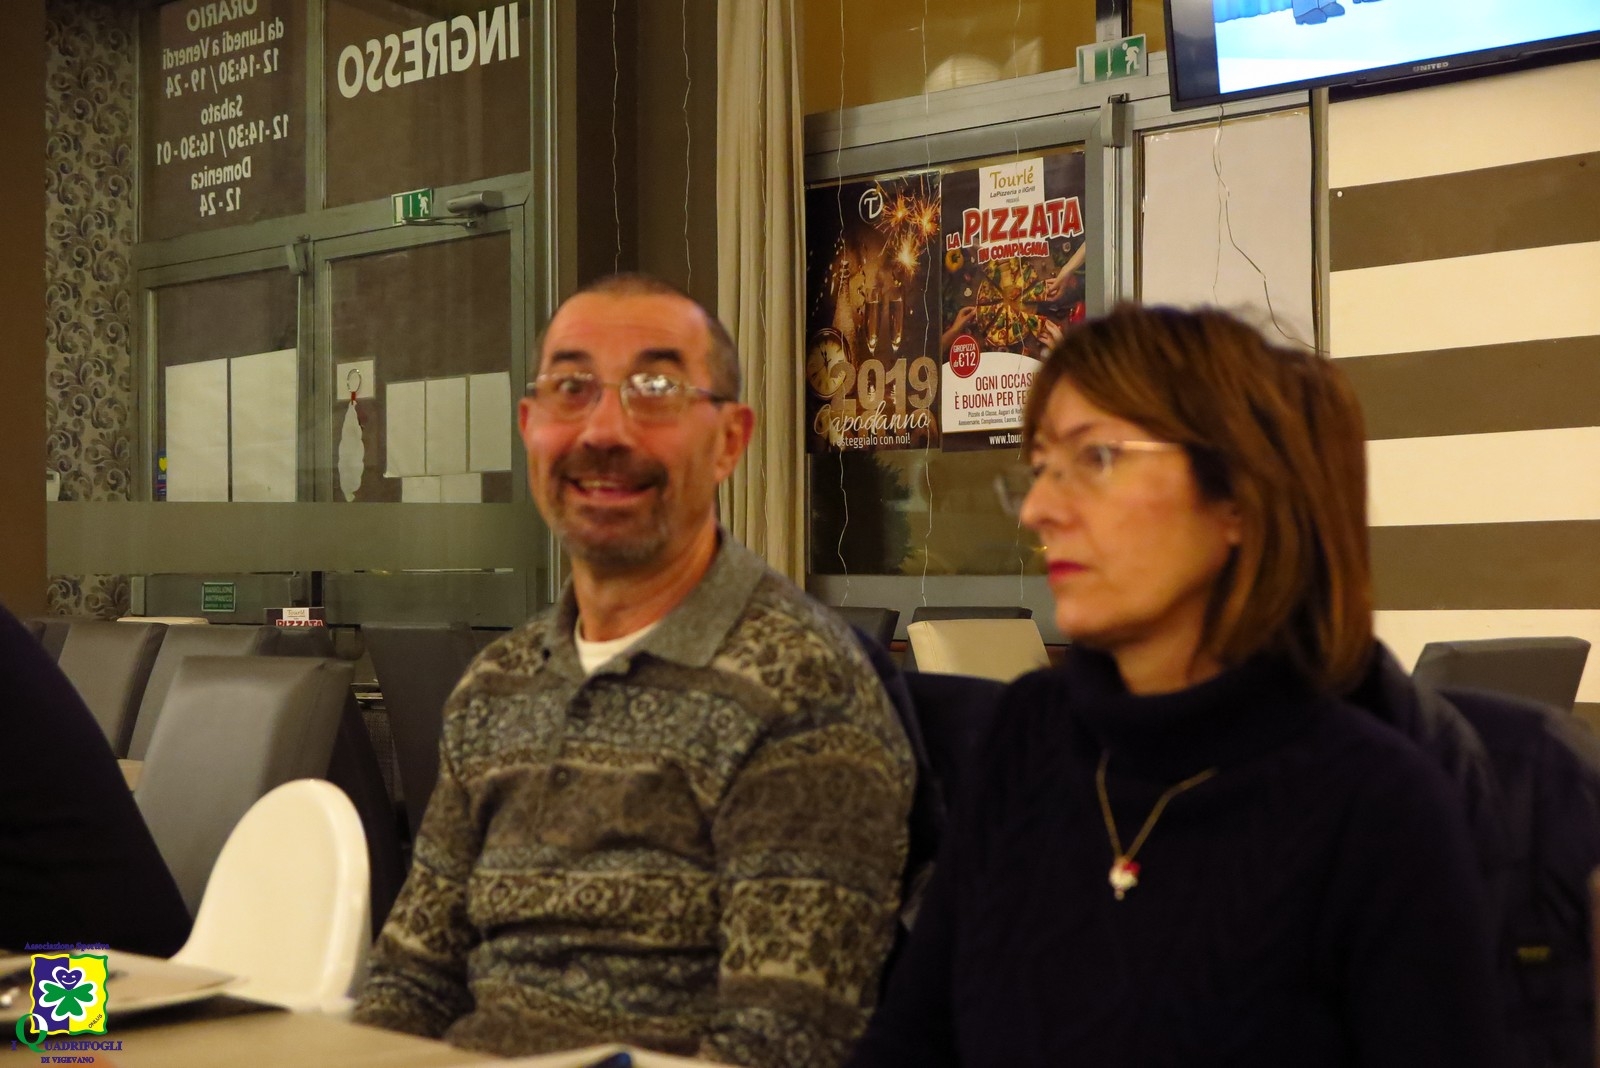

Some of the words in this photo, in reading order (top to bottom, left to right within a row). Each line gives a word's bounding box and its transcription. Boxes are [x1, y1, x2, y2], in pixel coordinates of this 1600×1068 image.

[1412, 61, 1449, 73] UNITED
[989, 165, 1034, 190] Tourlé
[946, 231, 962, 251] LA
[962, 196, 1084, 248] PIZZATA
[978, 247, 990, 264] IN
[989, 240, 1049, 260] COMPAGNIA
[958, 351, 976, 367] €12
[829, 356, 939, 415] 2019
[975, 375, 998, 391] OGNI
[1001, 372, 1037, 389] OCCASI
[954, 391, 960, 410] È
[962, 393, 994, 409] BUONA
[996, 391, 1014, 407] PER
[814, 400, 931, 440] Capodanno
[832, 434, 878, 449] esteggialo
[879, 435, 894, 445] con
[895, 432, 911, 445] noi!
